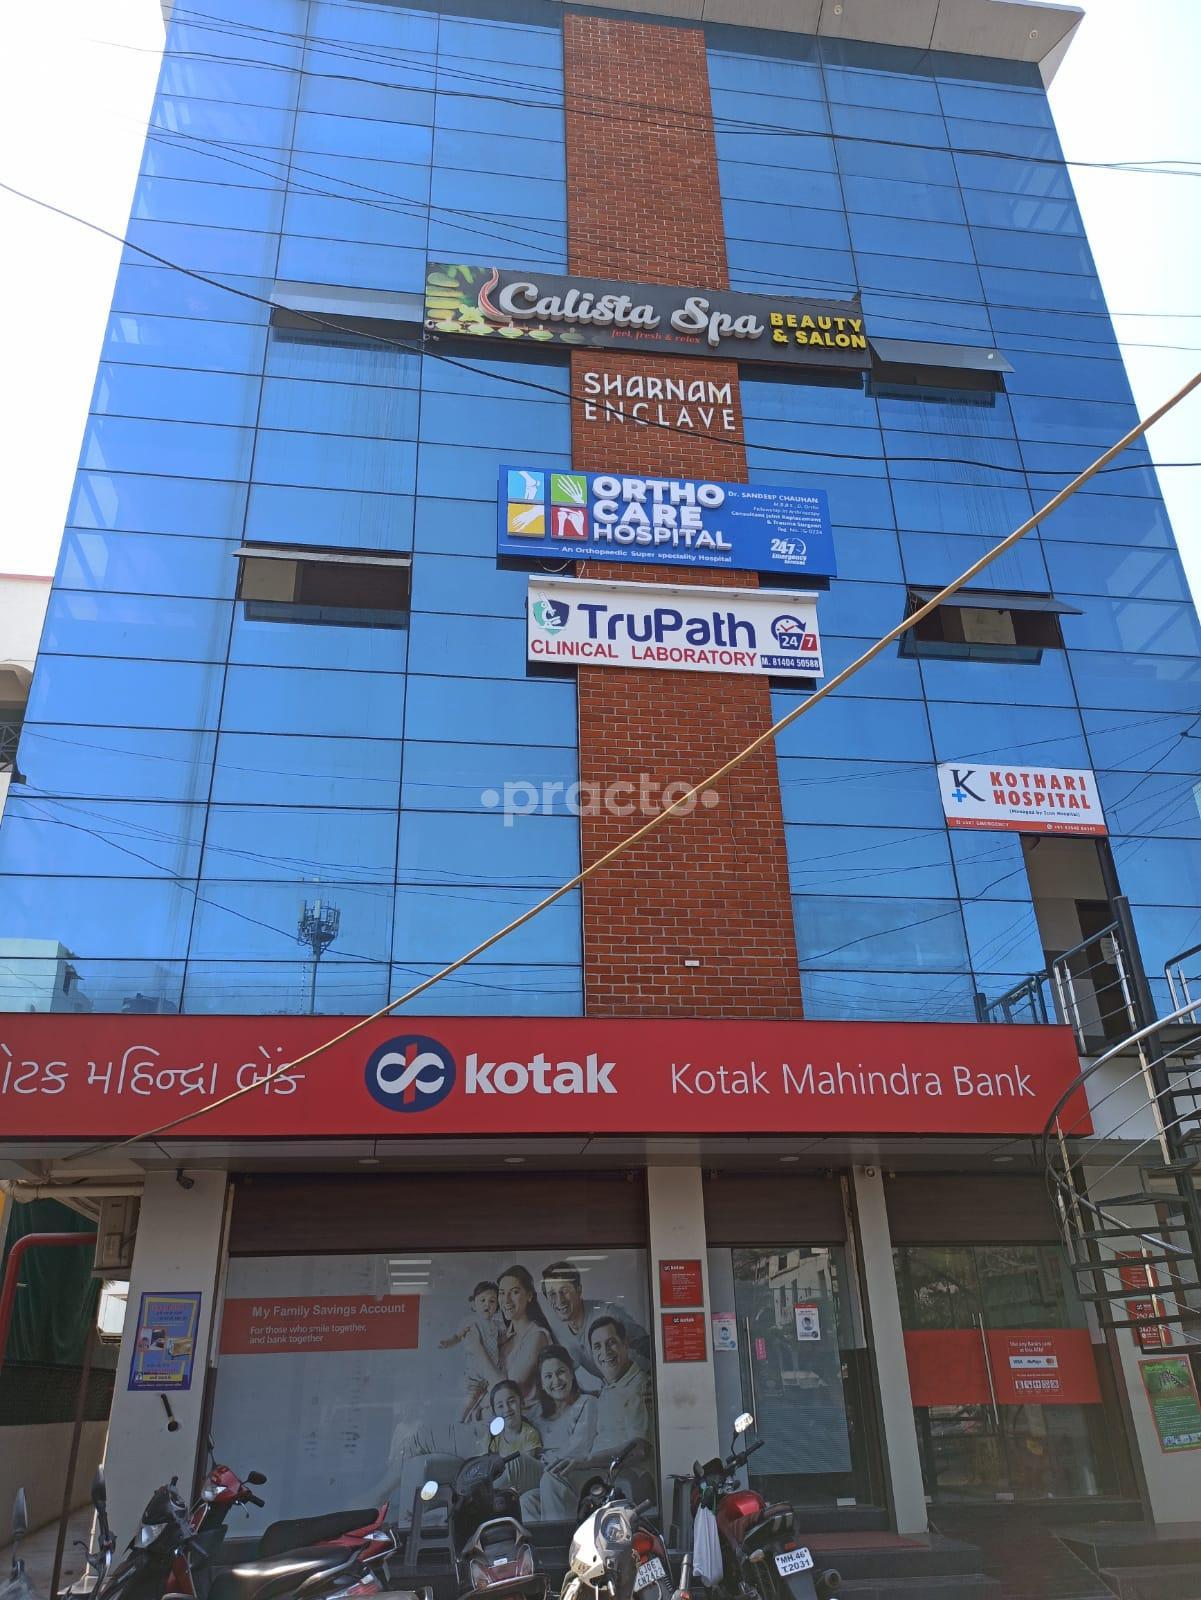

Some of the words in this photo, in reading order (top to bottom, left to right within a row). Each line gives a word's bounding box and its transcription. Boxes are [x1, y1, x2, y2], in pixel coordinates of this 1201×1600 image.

[499, 282, 661, 330] Calista
[670, 296, 765, 348] Spa
[769, 312, 862, 333] BEAUTY
[772, 328, 789, 344] &
[796, 330, 867, 349] SALON
[584, 372, 733, 406] SHARNAM
[584, 398, 737, 431] ENCLAVE
[592, 475, 726, 509] ORTHO
[728, 490, 740, 498] Dr.
[741, 491, 777, 500] SANDEEP
[779, 495, 819, 504] CHAUHAN
[592, 499, 703, 531] CARE
[593, 522, 733, 551] HOSPITAL
[575, 546, 628, 557] Orthopaedic
[631, 550, 655, 559] Super
[698, 554, 732, 563] Hospital
[576, 603, 757, 649] TruPath
[530, 639, 619, 659] CLINICAL
[631, 645, 757, 667] LABORATORY
[761, 656, 771, 666] M.
[772, 657, 795, 667] 81404
[949, 769, 987, 802] K
[989, 771, 1087, 791] KOTHARI
[993, 789, 1091, 810] HOSPITAL
[0, 1042, 69, 1095] ોટક
[464, 1052, 618, 1095] kotak
[671, 1061, 770, 1095] Kotak
[782, 1062, 942, 1096] Mahindra
[953, 1064, 1036, 1097] Bank
[251, 1306, 271, 1320] My
[273, 1304, 310, 1319] Family
[312, 1303, 357, 1317] Savings
[359, 1303, 406, 1316] Account
[249, 1336, 265, 1345] and
[266, 1335, 287, 1344] bank
[289, 1334, 324, 1345] together
[250, 1326, 265, 1335] For
[265, 1326, 288, 1335] those
[289, 1326, 308, 1334] who
[308, 1324, 330, 1333] smile
[780, 1551, 806, 1564] MH.46
[781, 1559, 811, 1574] T2031
